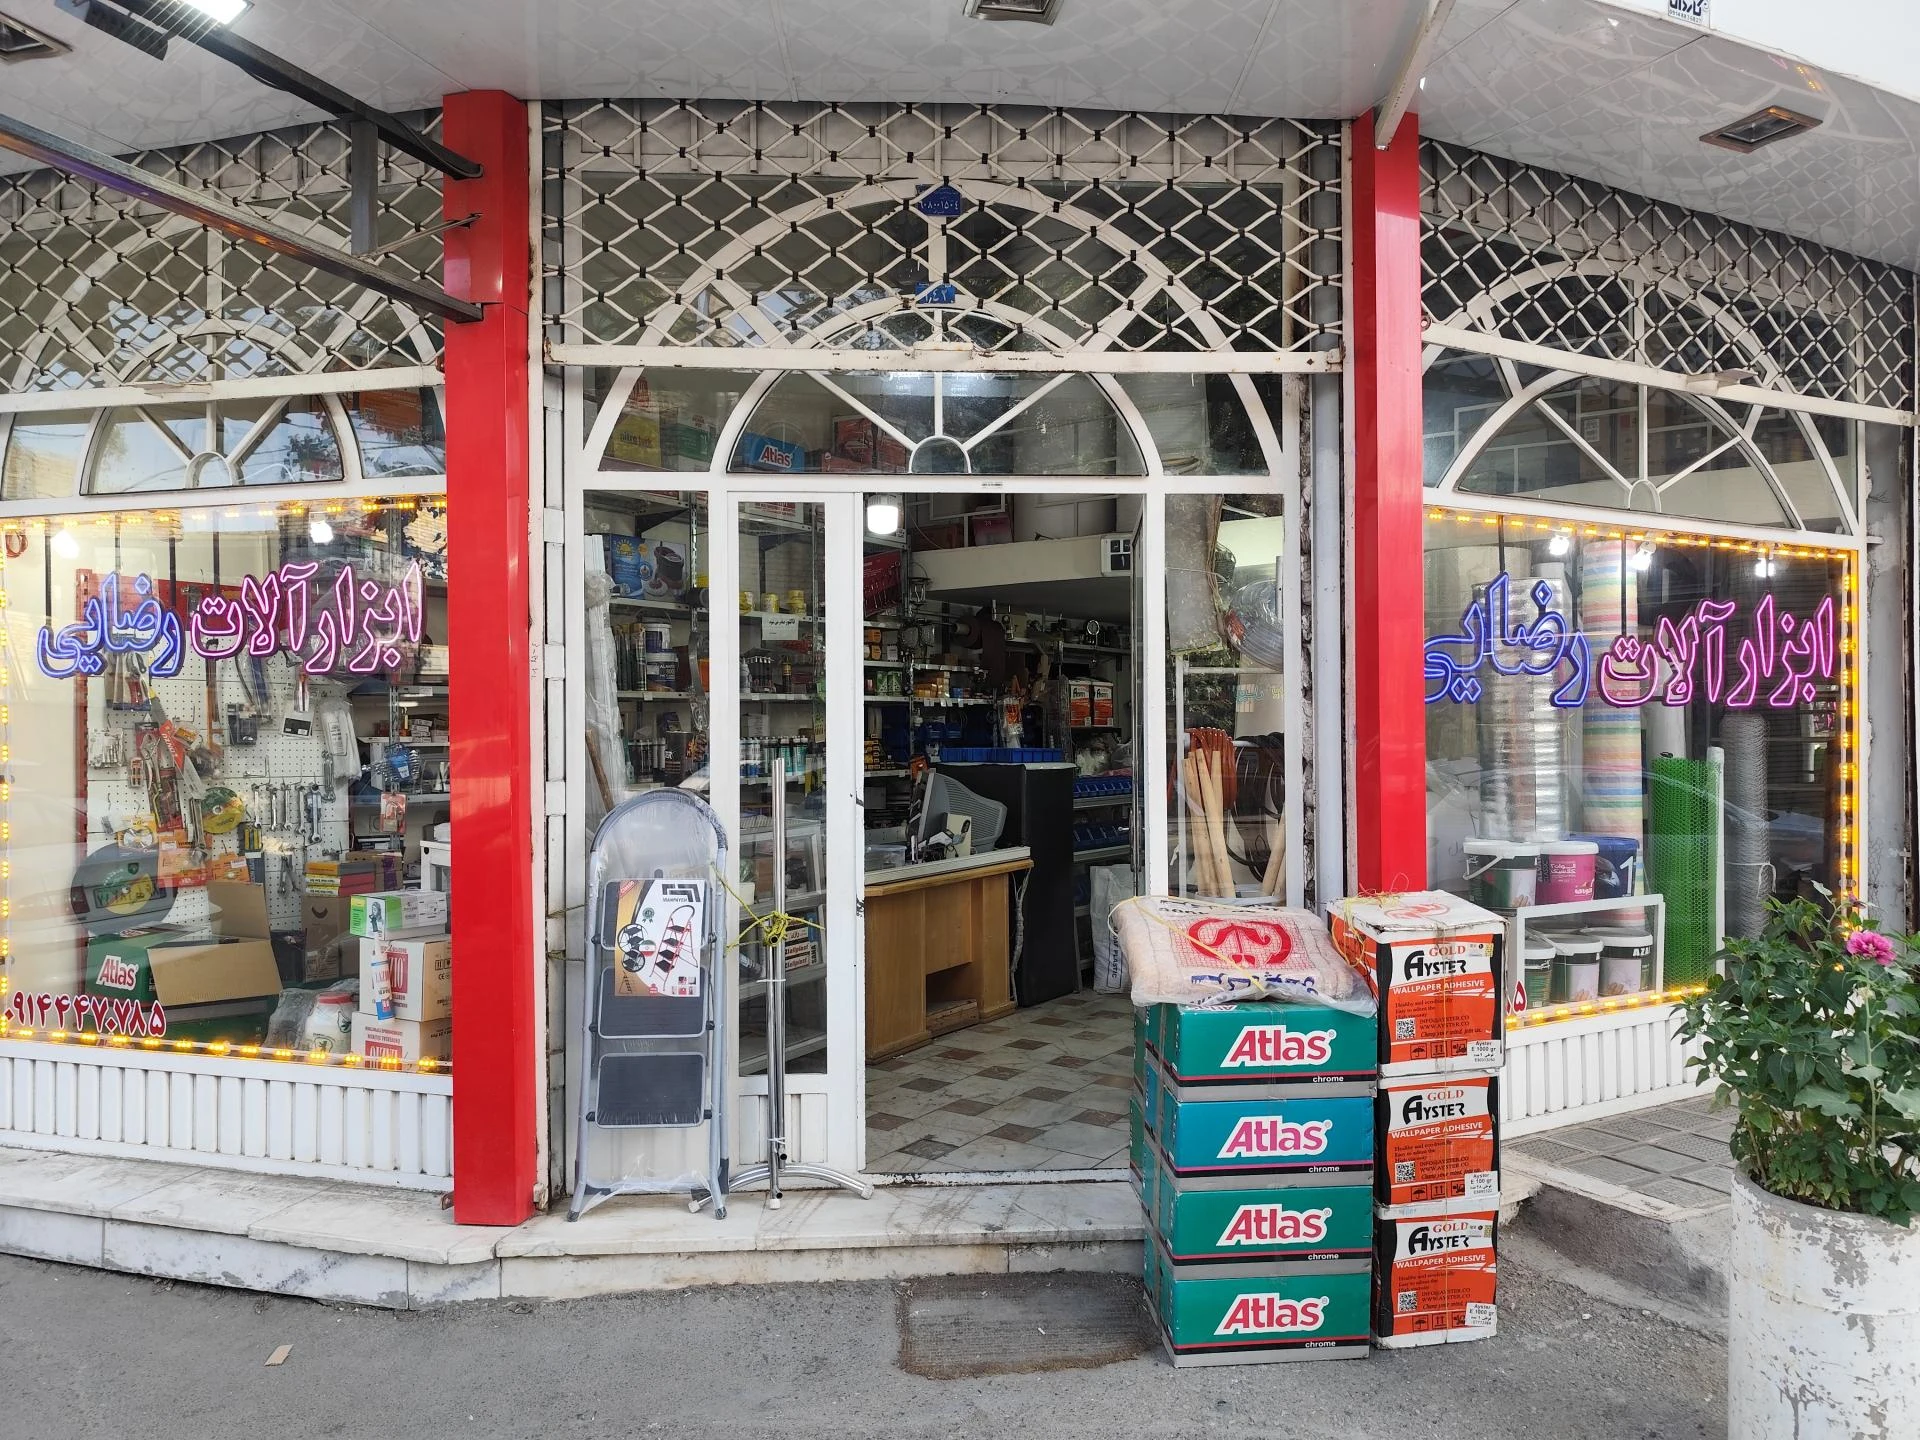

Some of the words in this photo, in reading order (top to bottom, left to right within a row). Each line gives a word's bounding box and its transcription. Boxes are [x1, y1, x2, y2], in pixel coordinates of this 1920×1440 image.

[760, 446, 792, 467] Atlas
[190, 561, 320, 660] آلات
[304, 560, 426, 676] ابزار
[36, 571, 187, 679] رضایی
[1598, 599, 1736, 708] آلات
[1725, 593, 1836, 708] ابزار
[1428, 945, 1466, 957] GOLD
[98, 957, 136, 988] Atlas
[1393, 983, 1442, 995] WALLPAPER
[1443, 979, 1485, 990] ADHESIVE
[3, 990, 168, 1038] ۰۹۱۴۴۴۷۰۷۸۵
[1229, 1029, 1329, 1063] Atlas
[1311, 1075, 1344, 1084] chrome
[1427, 1089, 1464, 1101] GOLD
[1225, 1119, 1325, 1154] Atlas
[1391, 1127, 1441, 1139] WALLPAPER
[1442, 1121, 1483, 1133] ADHESIVE
[1308, 1165, 1340, 1173] chrome
[1224, 1208, 1324, 1242] Atlas
[1432, 1221, 1469, 1234] GOLD
[1307, 1252, 1340, 1261] chrome
[1396, 1256, 1444, 1269] WALLPAPER
[1445, 1254, 1486, 1264] ADHESIVE
[1222, 1297, 1321, 1331] Atlas
[1305, 1340, 1336, 1349] chrome
